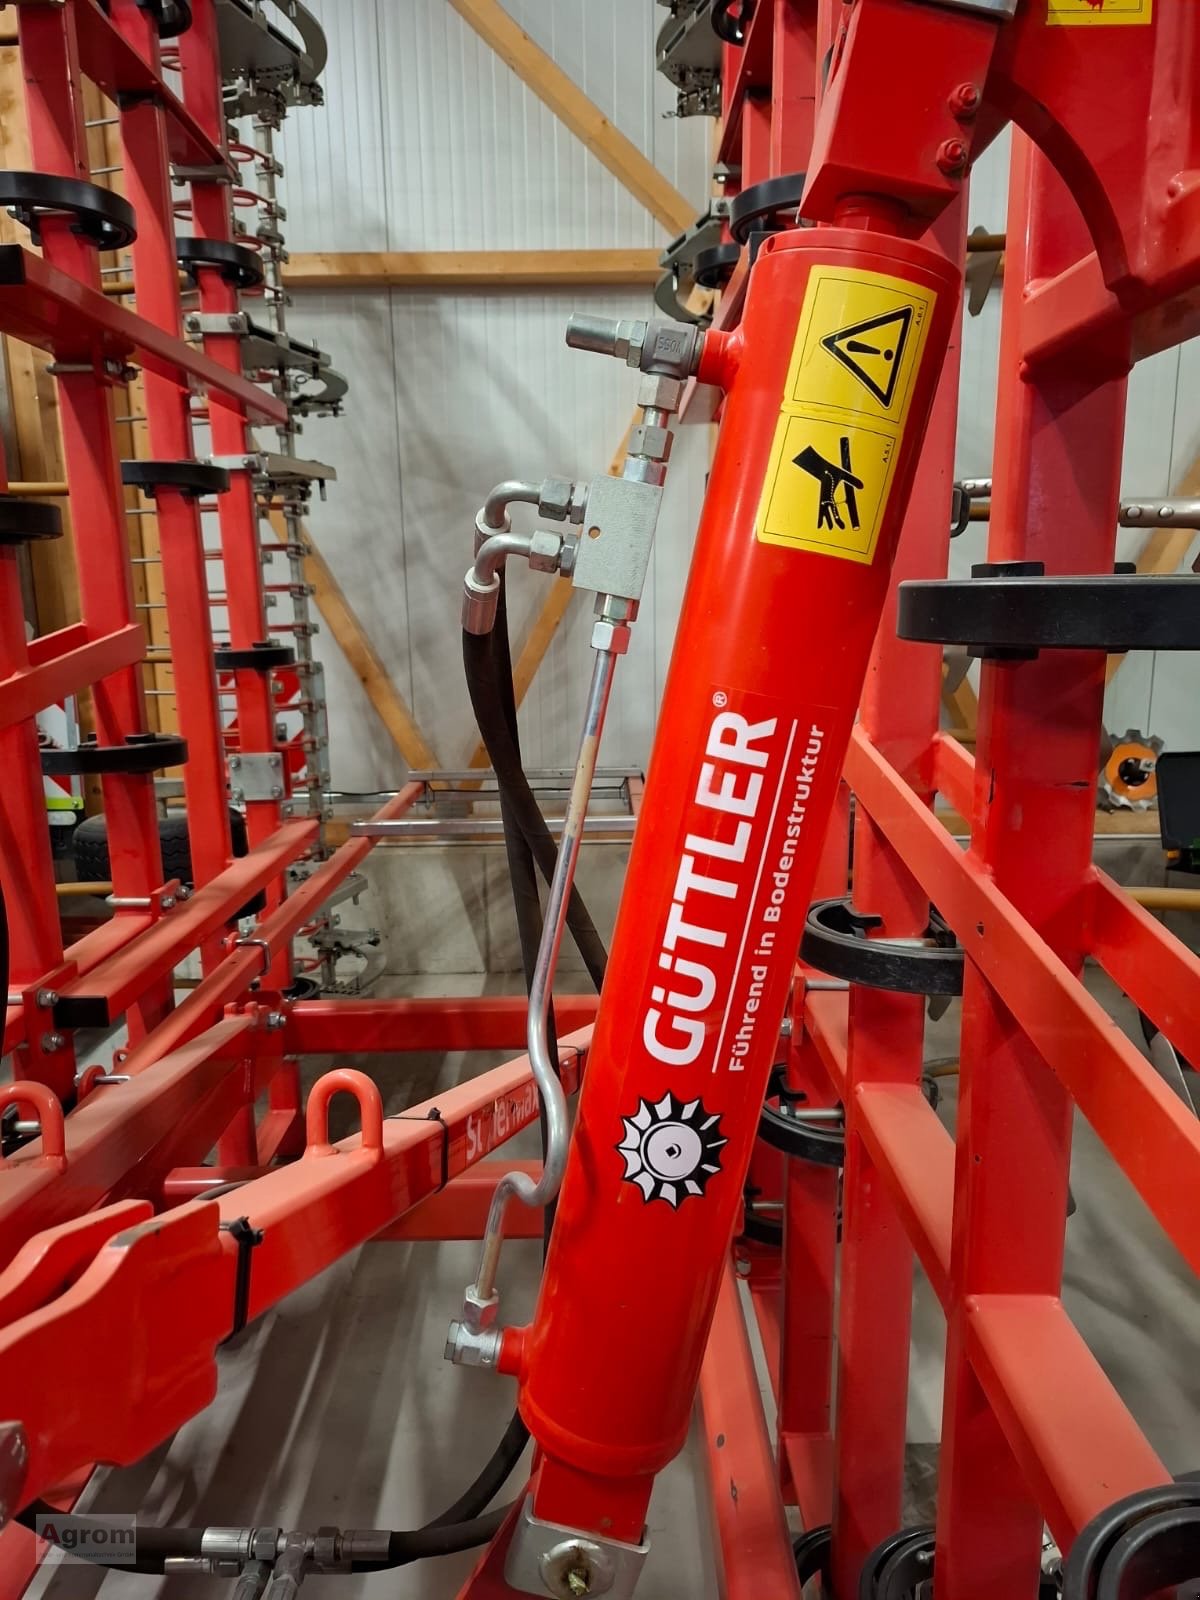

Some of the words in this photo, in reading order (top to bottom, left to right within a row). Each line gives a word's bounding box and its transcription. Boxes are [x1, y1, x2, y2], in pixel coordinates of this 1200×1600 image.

[762, 724, 825, 922] Bodenstruktur
[753, 931, 777, 956] in
[727, 965, 769, 1073] Führend
